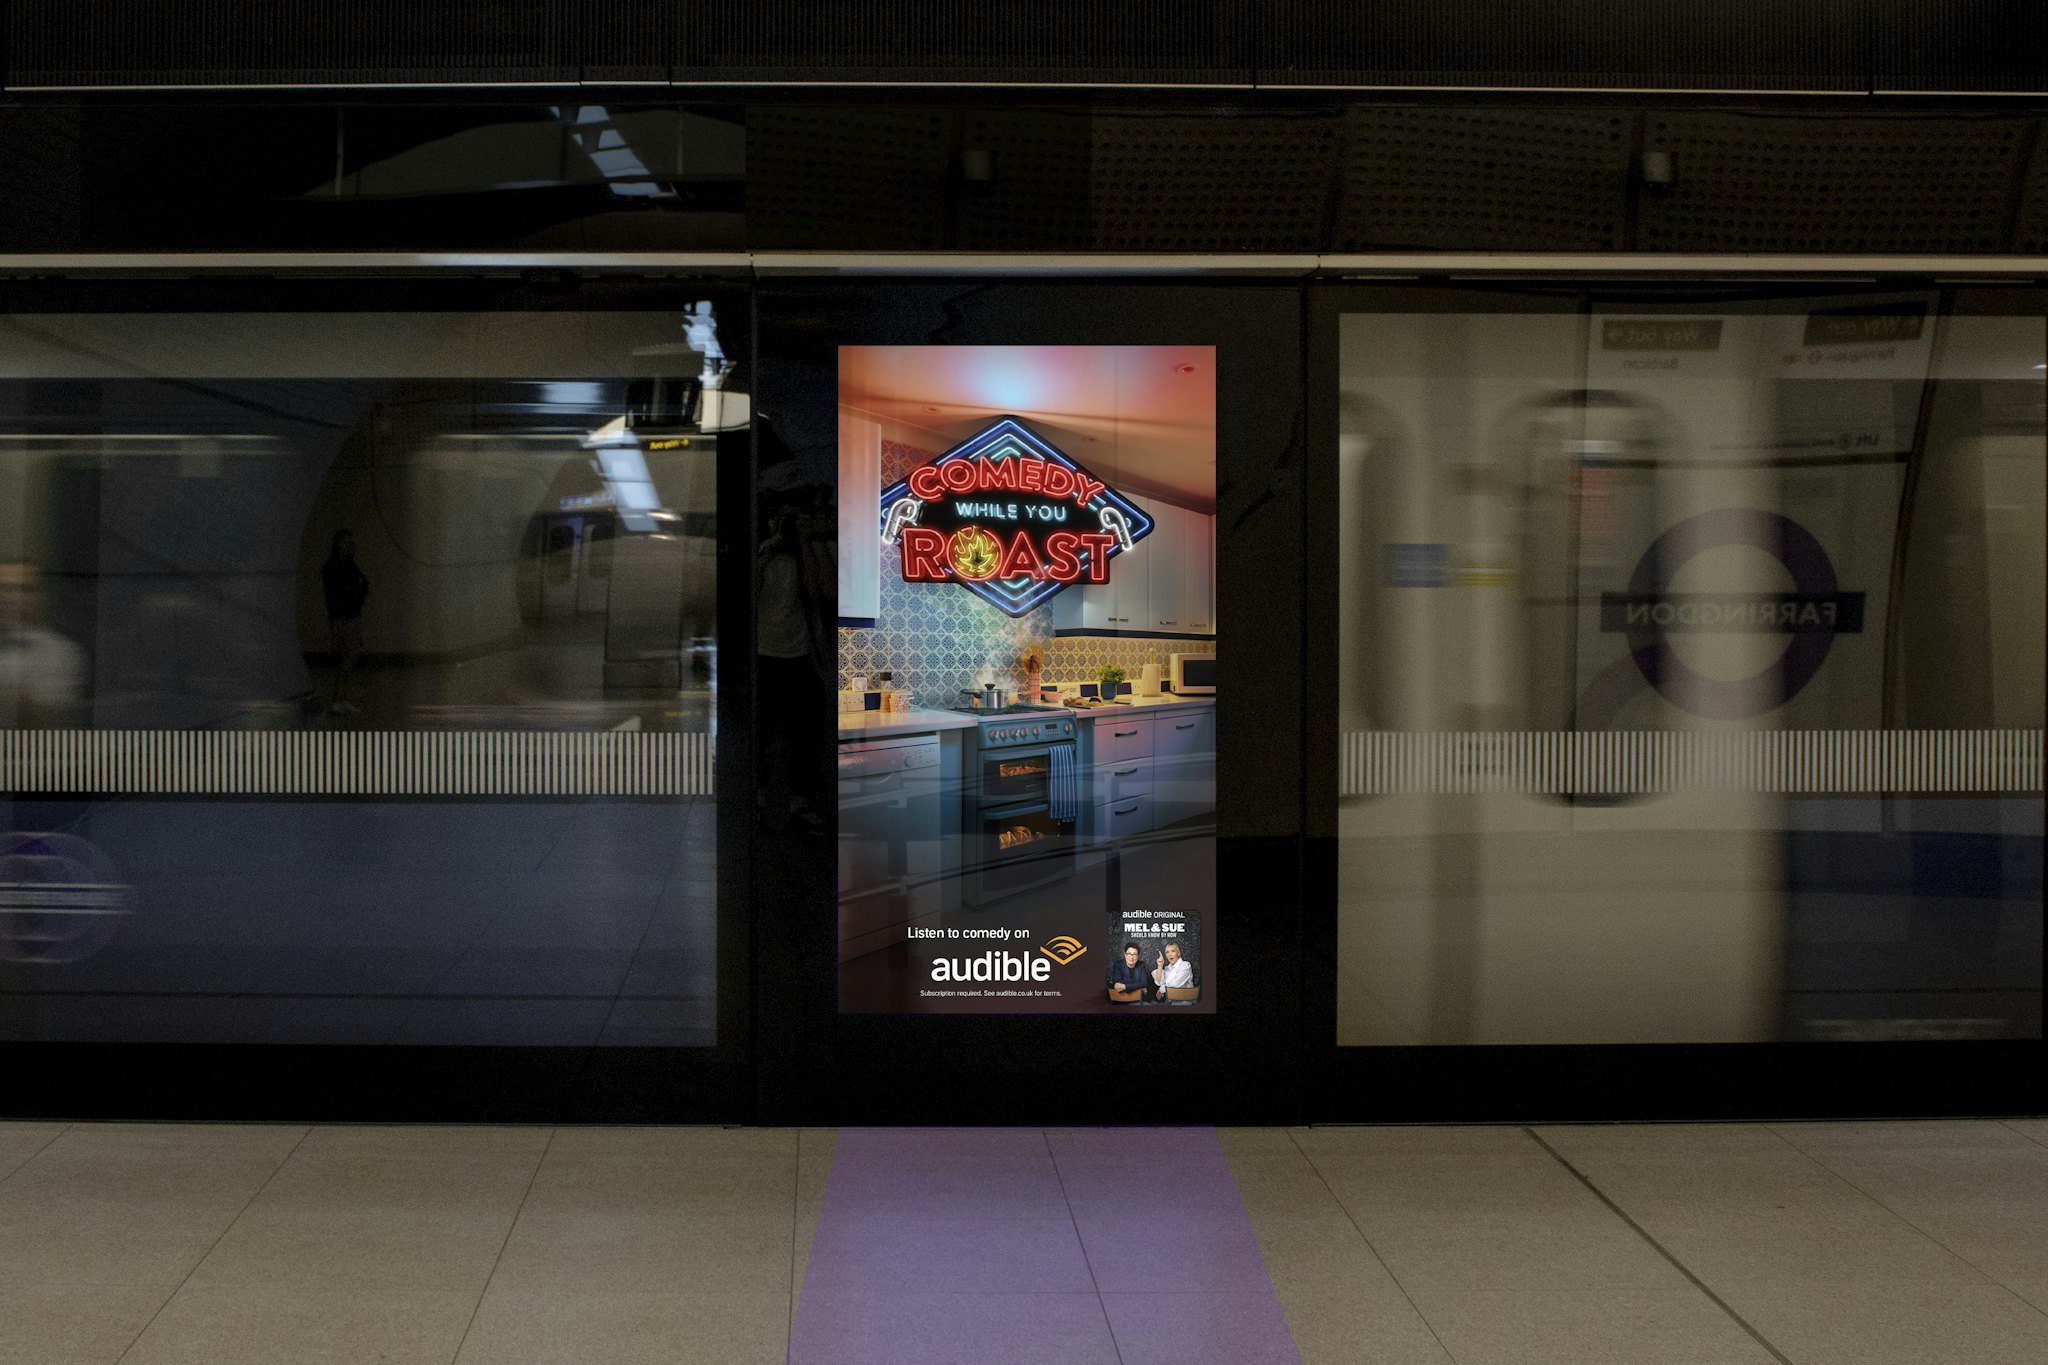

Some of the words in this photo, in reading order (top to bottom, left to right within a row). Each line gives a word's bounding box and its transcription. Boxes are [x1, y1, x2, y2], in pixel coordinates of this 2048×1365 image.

[909, 456, 1105, 505] COMEDY
[955, 501, 1018, 520] WHILE
[1024, 503, 1067, 522] YOU
[901, 526, 1114, 581] ROAST
[1122, 910, 1152, 918] audible
[907, 927, 945, 939] Listen
[947, 928, 960, 939] to
[962, 927, 1011, 941] comedy
[1014, 929, 1030, 939] on
[1124, 923, 1150, 932] MEL
[1151, 923, 1161, 932] &
[1162, 923, 1185, 932] SUE
[931, 951, 1051, 982] audible
[920, 989, 956, 997] Subscription
[957, 989, 982, 997] required.
[983, 989, 995, 997] See
[995, 989, 1034, 997] audible.co.uk
[1034, 989, 1043, 997] for
[1043, 989, 1062, 997] terms.
